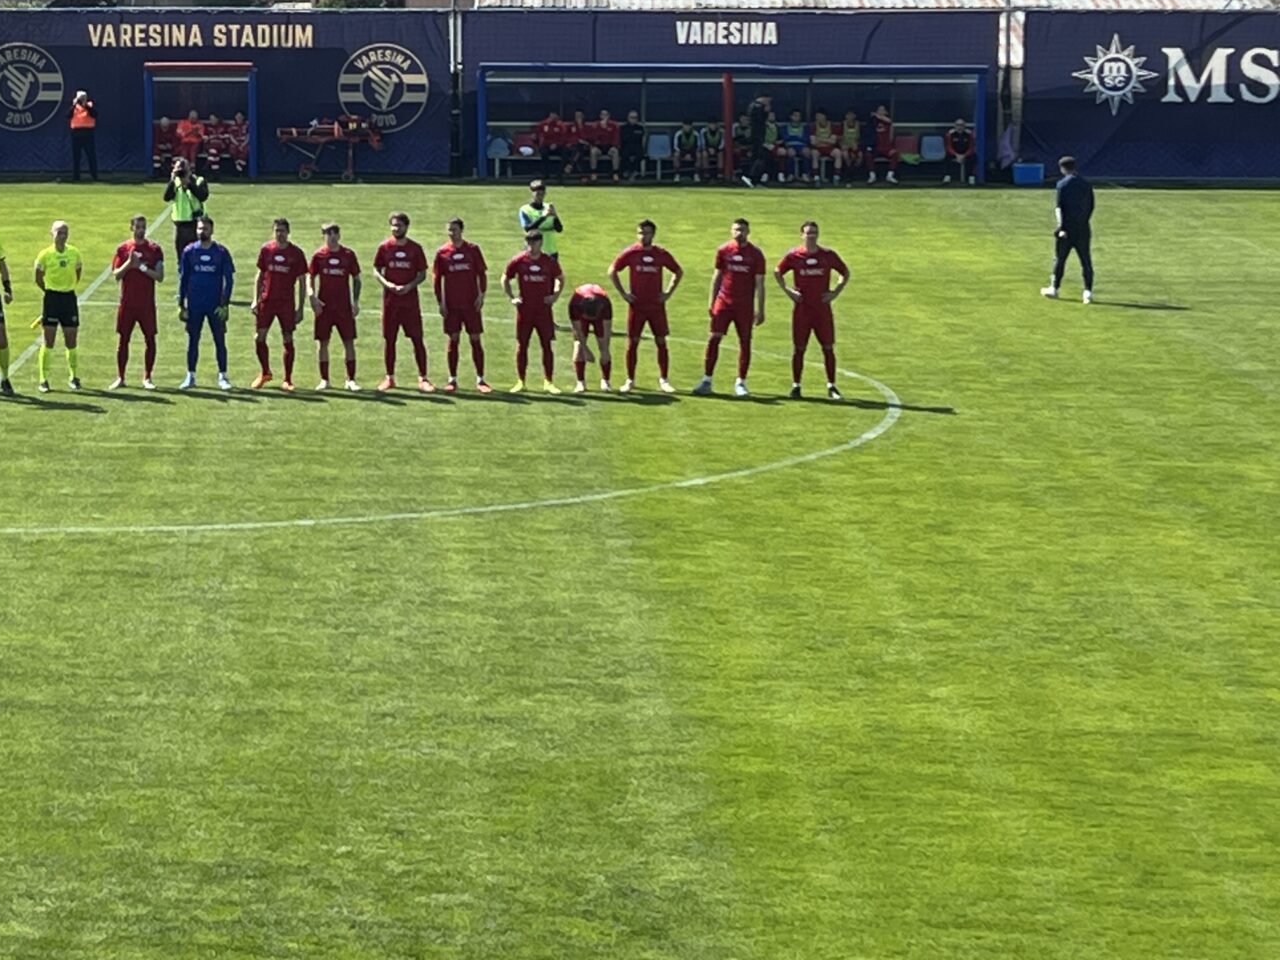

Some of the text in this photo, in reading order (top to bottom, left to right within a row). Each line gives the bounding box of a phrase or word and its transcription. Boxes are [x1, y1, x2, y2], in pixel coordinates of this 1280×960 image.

[87, 23, 314, 48] VARESINA STADIUM
[675, 21, 778, 45] VARESINA
[353, 49, 412, 71] VARESINA
[5, 111, 34, 125] 2010
